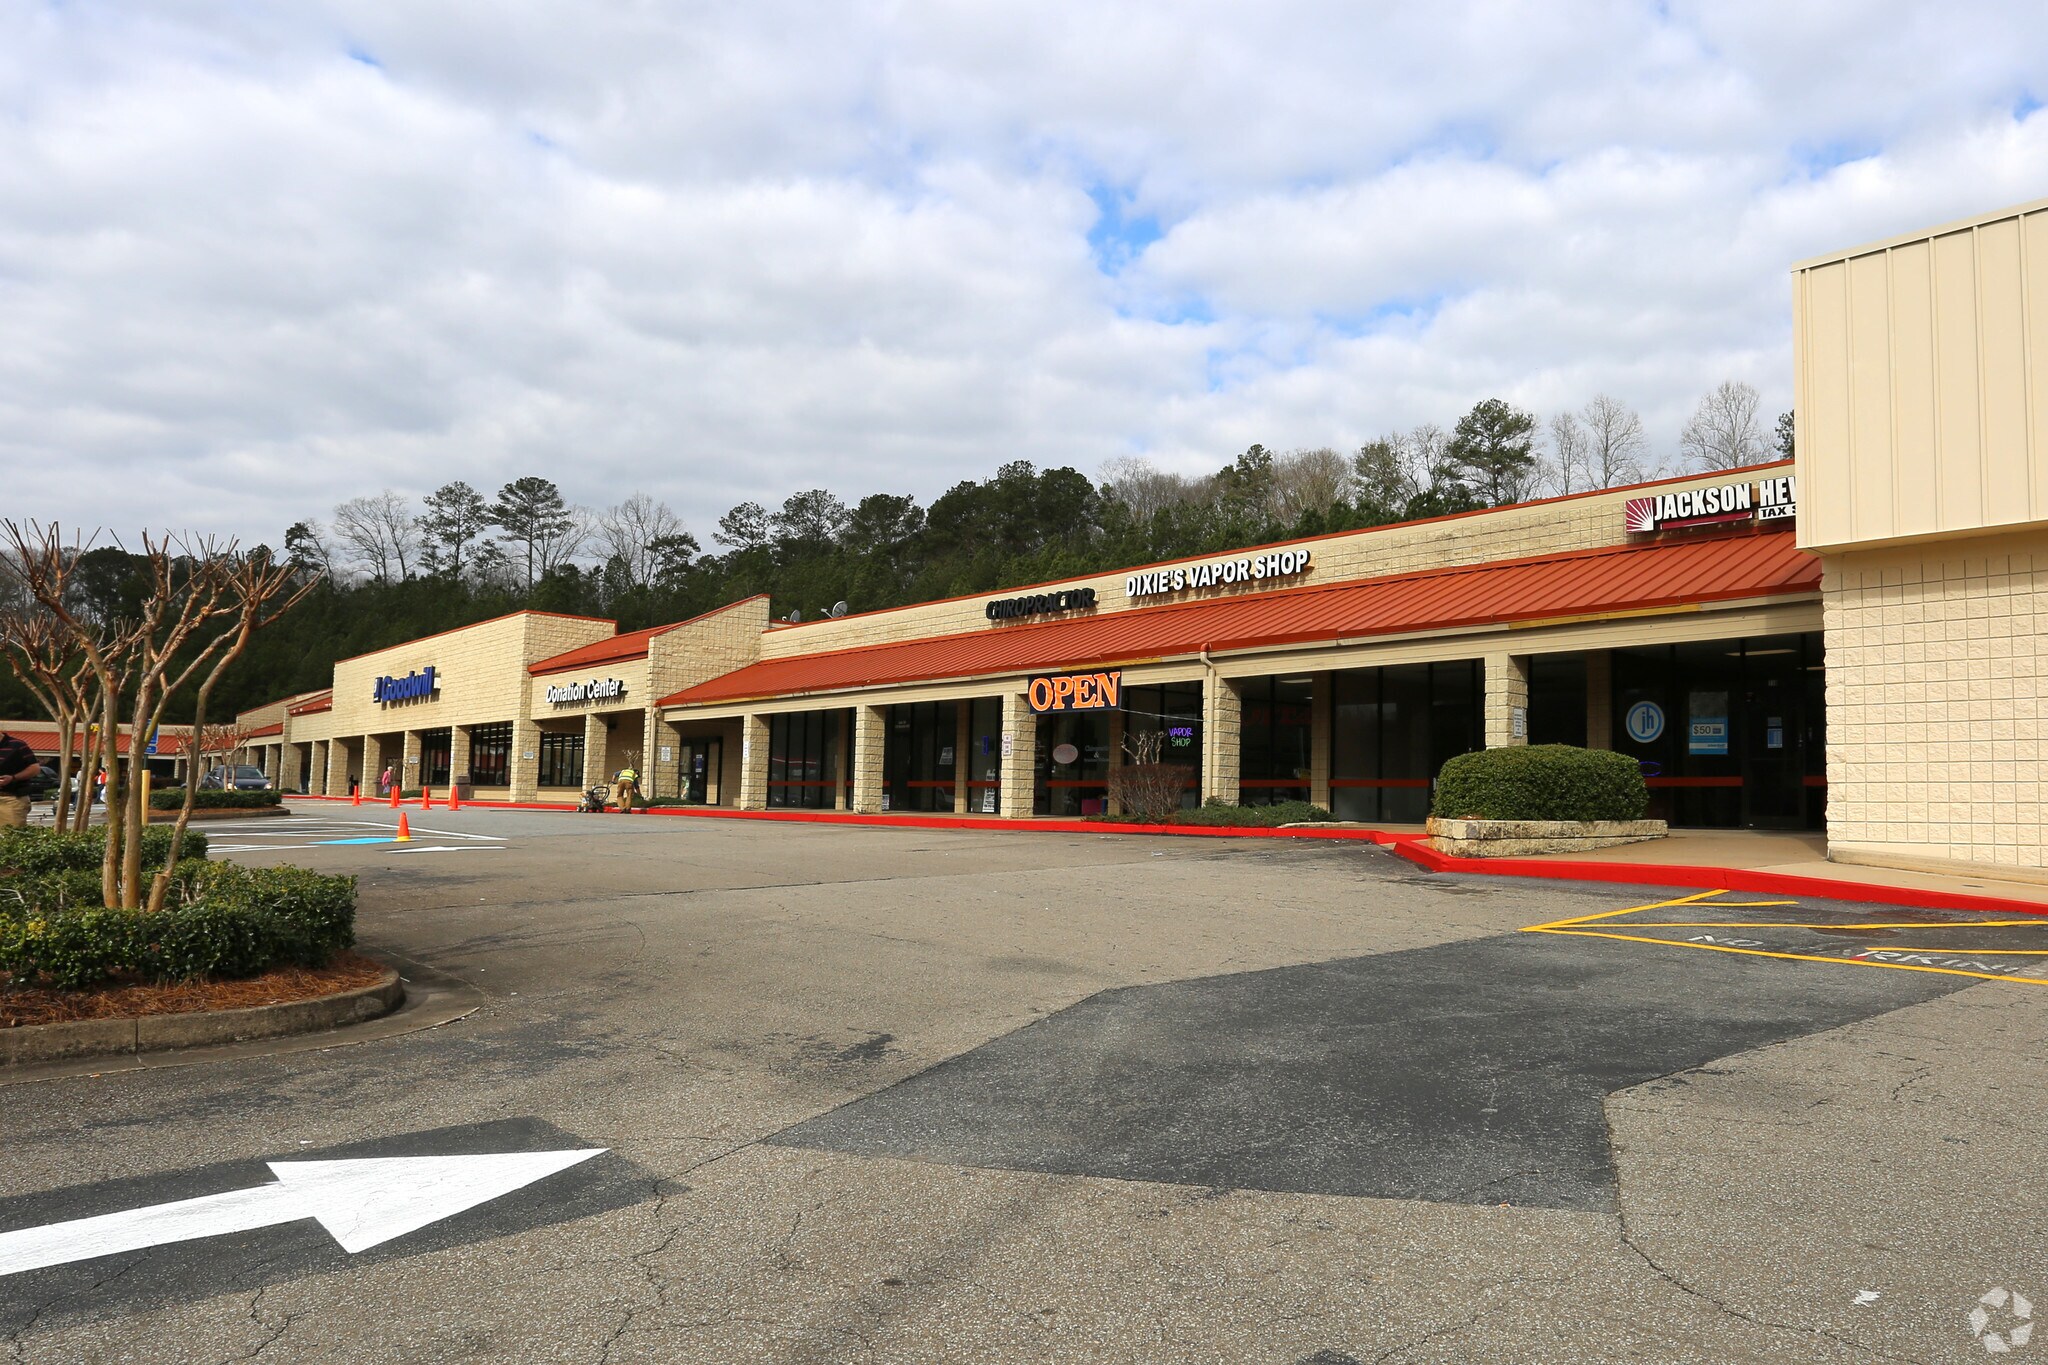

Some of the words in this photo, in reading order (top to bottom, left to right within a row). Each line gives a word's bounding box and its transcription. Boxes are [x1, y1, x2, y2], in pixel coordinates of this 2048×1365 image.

[1654, 483, 1751, 521] JACKSON
[1761, 507, 1787, 518] TAX
[1125, 570, 1185, 597] DIXIE'S
[1189, 559, 1251, 588] VAPOR
[1254, 549, 1310, 579] SHOP
[986, 588, 1095, 619] CHIROPRACTOR
[381, 666, 435, 702] Goodwill
[545, 684, 584, 704] Donation
[586, 679, 621, 701] Center
[1029, 672, 1120, 711] OPEN
[1168, 727, 1193, 737] VAPOR
[1171, 737, 1191, 747] SHOP
[1693, 725, 1711, 735] $50
[1686, 934, 1764, 947] NO
